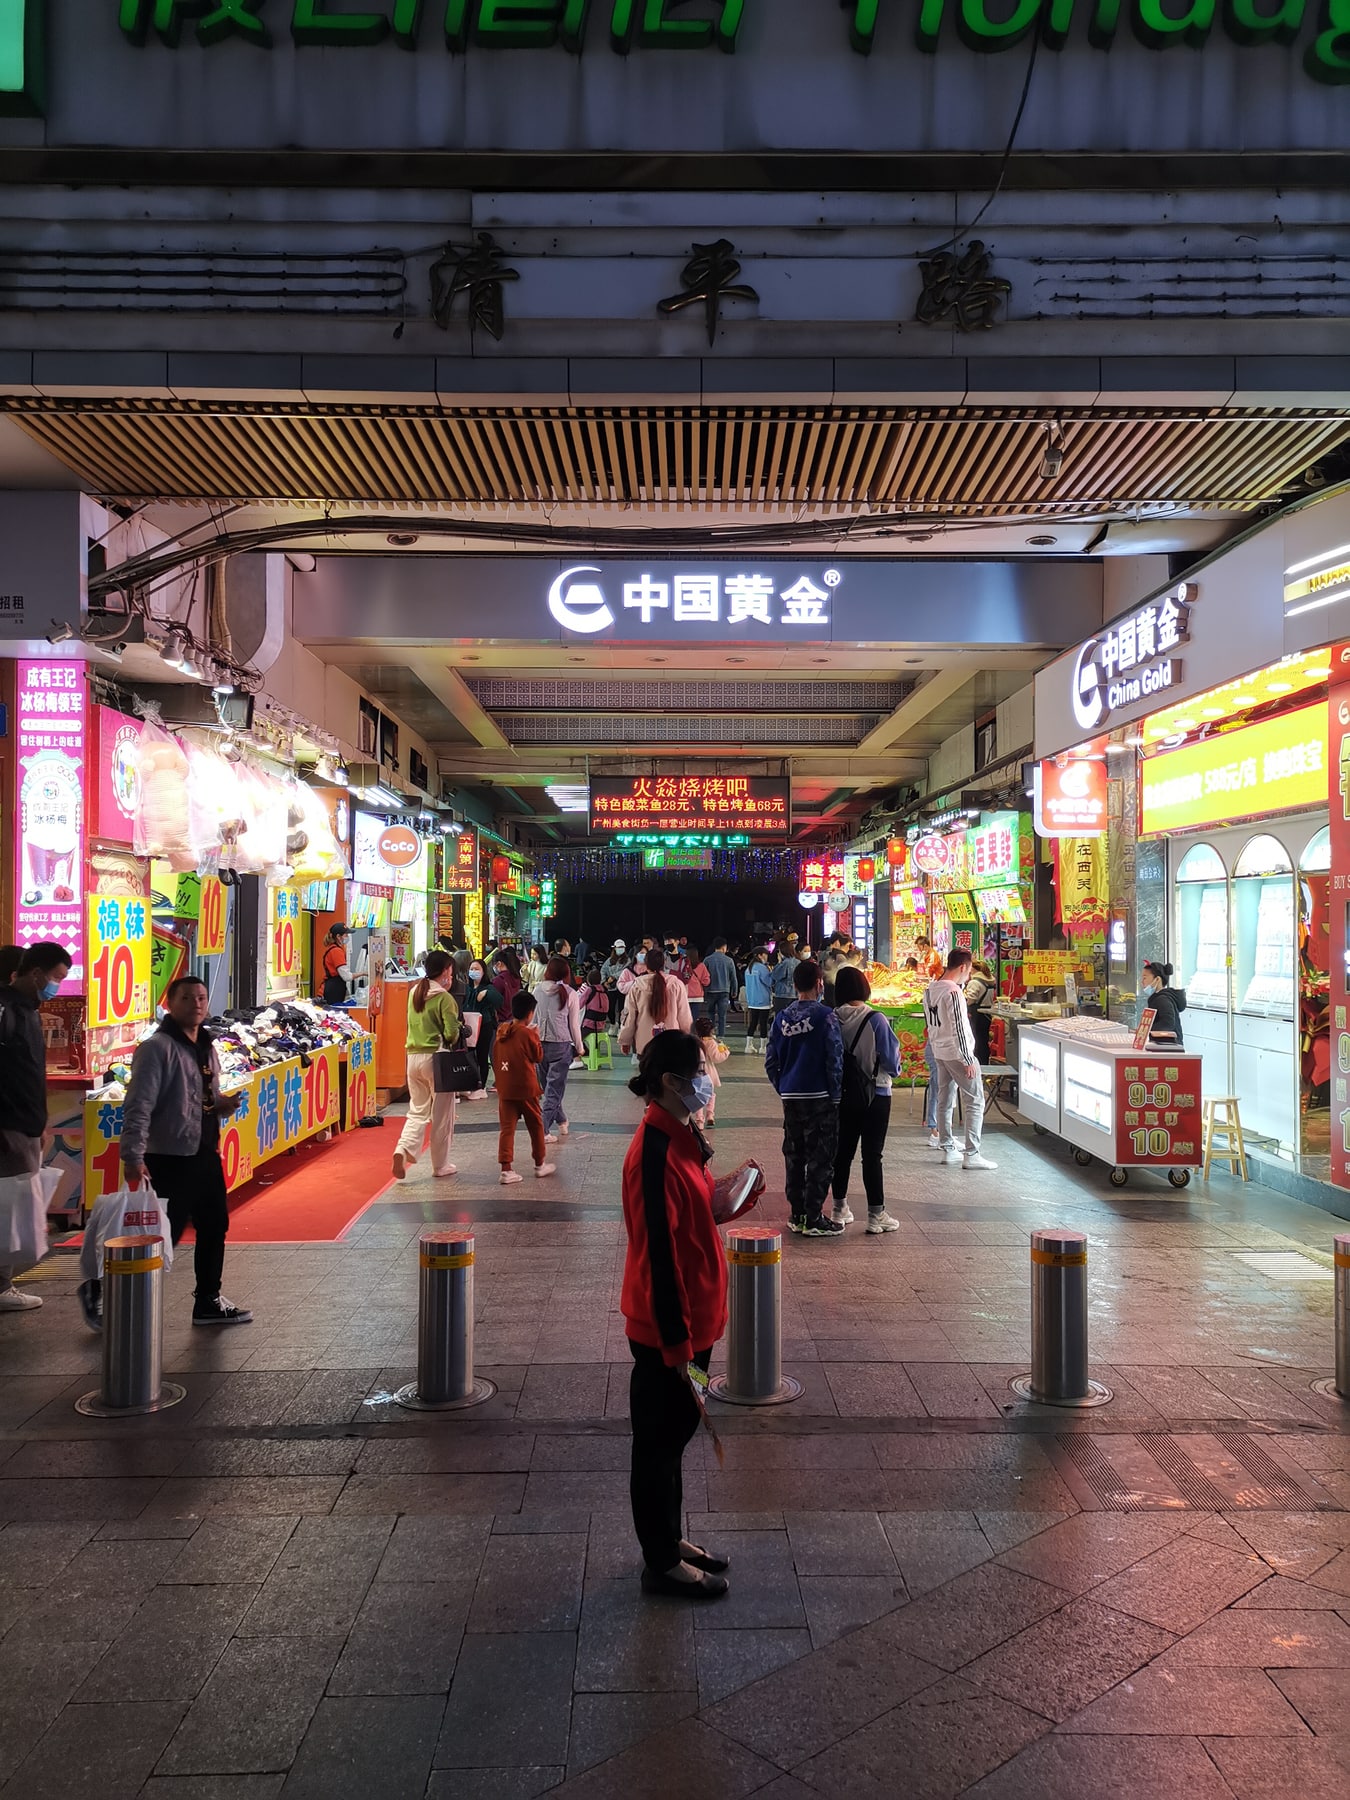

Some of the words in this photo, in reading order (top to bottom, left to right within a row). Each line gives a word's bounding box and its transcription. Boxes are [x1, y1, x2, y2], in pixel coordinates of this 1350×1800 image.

[623, 574, 829, 625] 中国黄金
[1101, 597, 1180, 679] 中国黄金
[1108, 678, 1140, 710] China
[1142, 659, 1172, 695] Gold
[382, 839, 415, 853] CoCo
[277, 890, 299, 918] 棉袜
[541, 881, 553, 916] 便利店
[1333, 875, 1346, 890] BUY
[97, 899, 146, 941] 棉袜
[203, 879, 222, 949] 10
[274, 920, 294, 974] 10
[93, 945, 134, 1022] 10
[350, 1037, 373, 1071] 棉袜
[256, 1066, 304, 1157] 棉袜
[304, 1054, 330, 1131] 10
[348, 1069, 368, 1126] 10
[1129, 1128, 1170, 1156] 10
